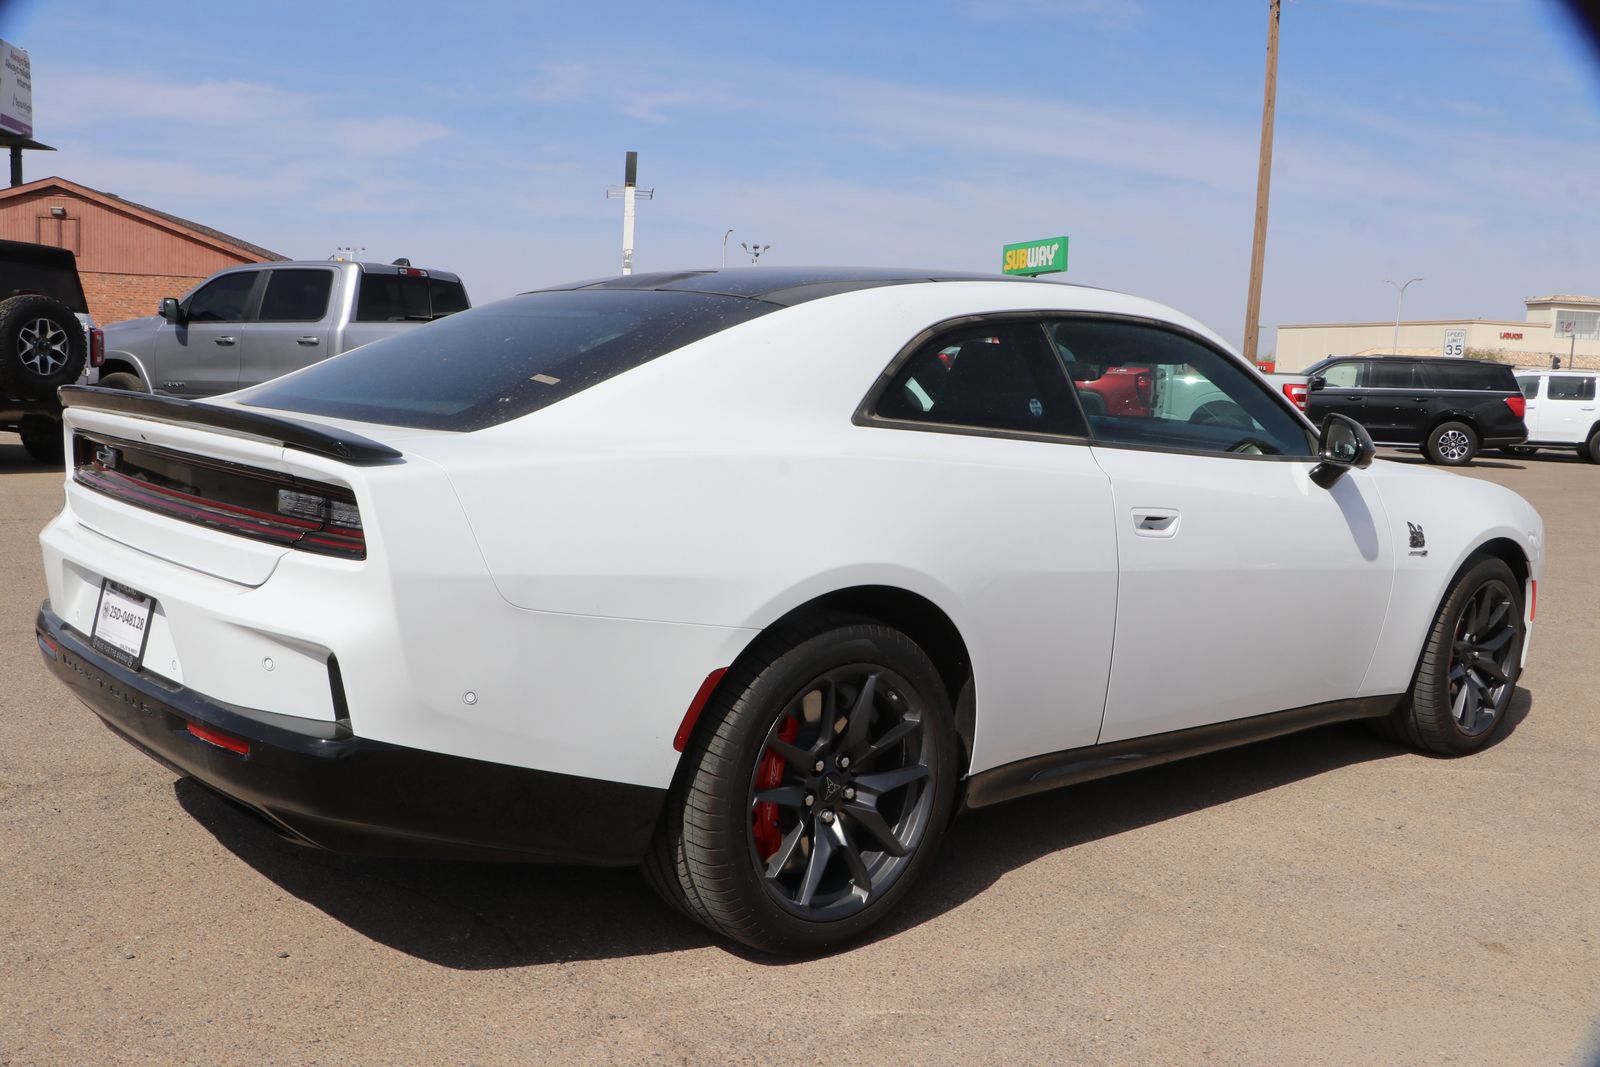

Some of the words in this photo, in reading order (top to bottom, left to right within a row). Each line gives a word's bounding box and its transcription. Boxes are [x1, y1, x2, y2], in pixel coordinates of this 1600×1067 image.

[1003, 242, 1059, 272] SUBWAY
[1499, 332, 1523, 340] LIQUOR
[1445, 345, 1463, 356] 35
[109, 605, 145, 631] 25D-048128
